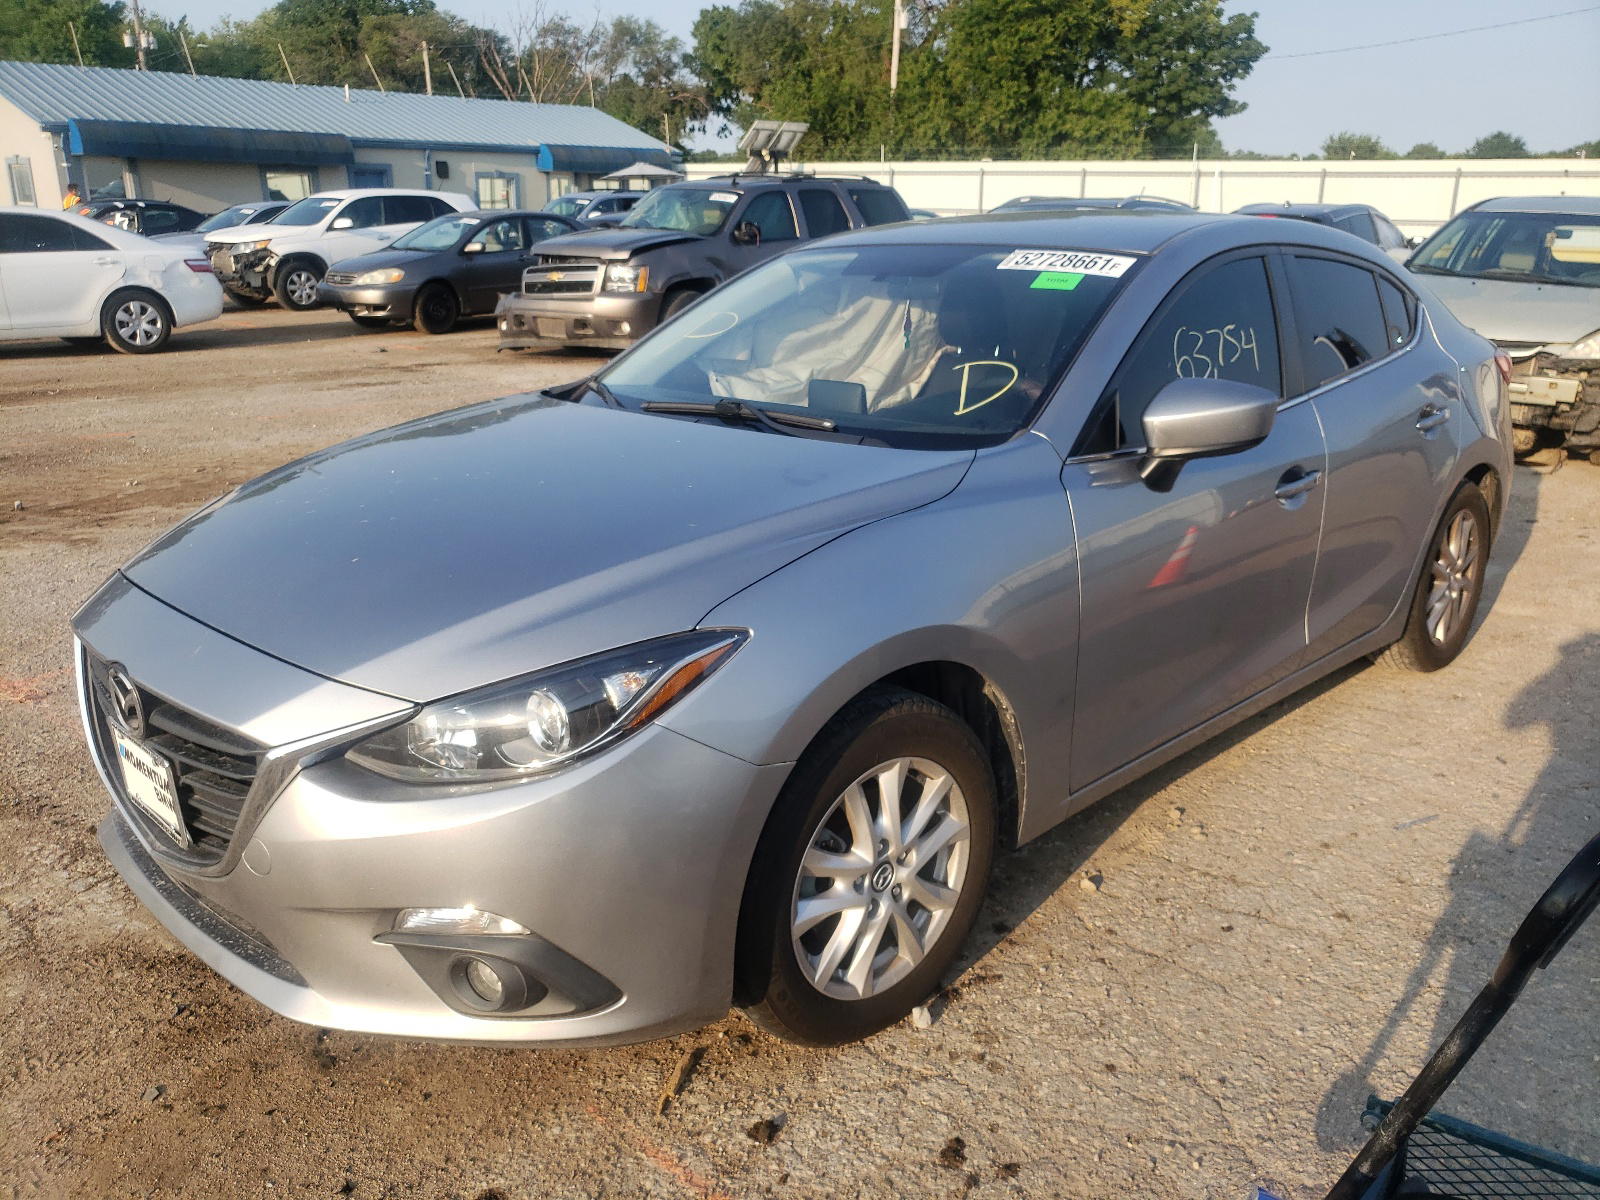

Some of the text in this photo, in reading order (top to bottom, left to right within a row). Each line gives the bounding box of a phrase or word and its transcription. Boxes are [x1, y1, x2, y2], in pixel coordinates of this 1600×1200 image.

[1014, 252, 1113, 271] 52728661
[952, 360, 1019, 416] D
[124, 746, 170, 793] MOMENTUM
